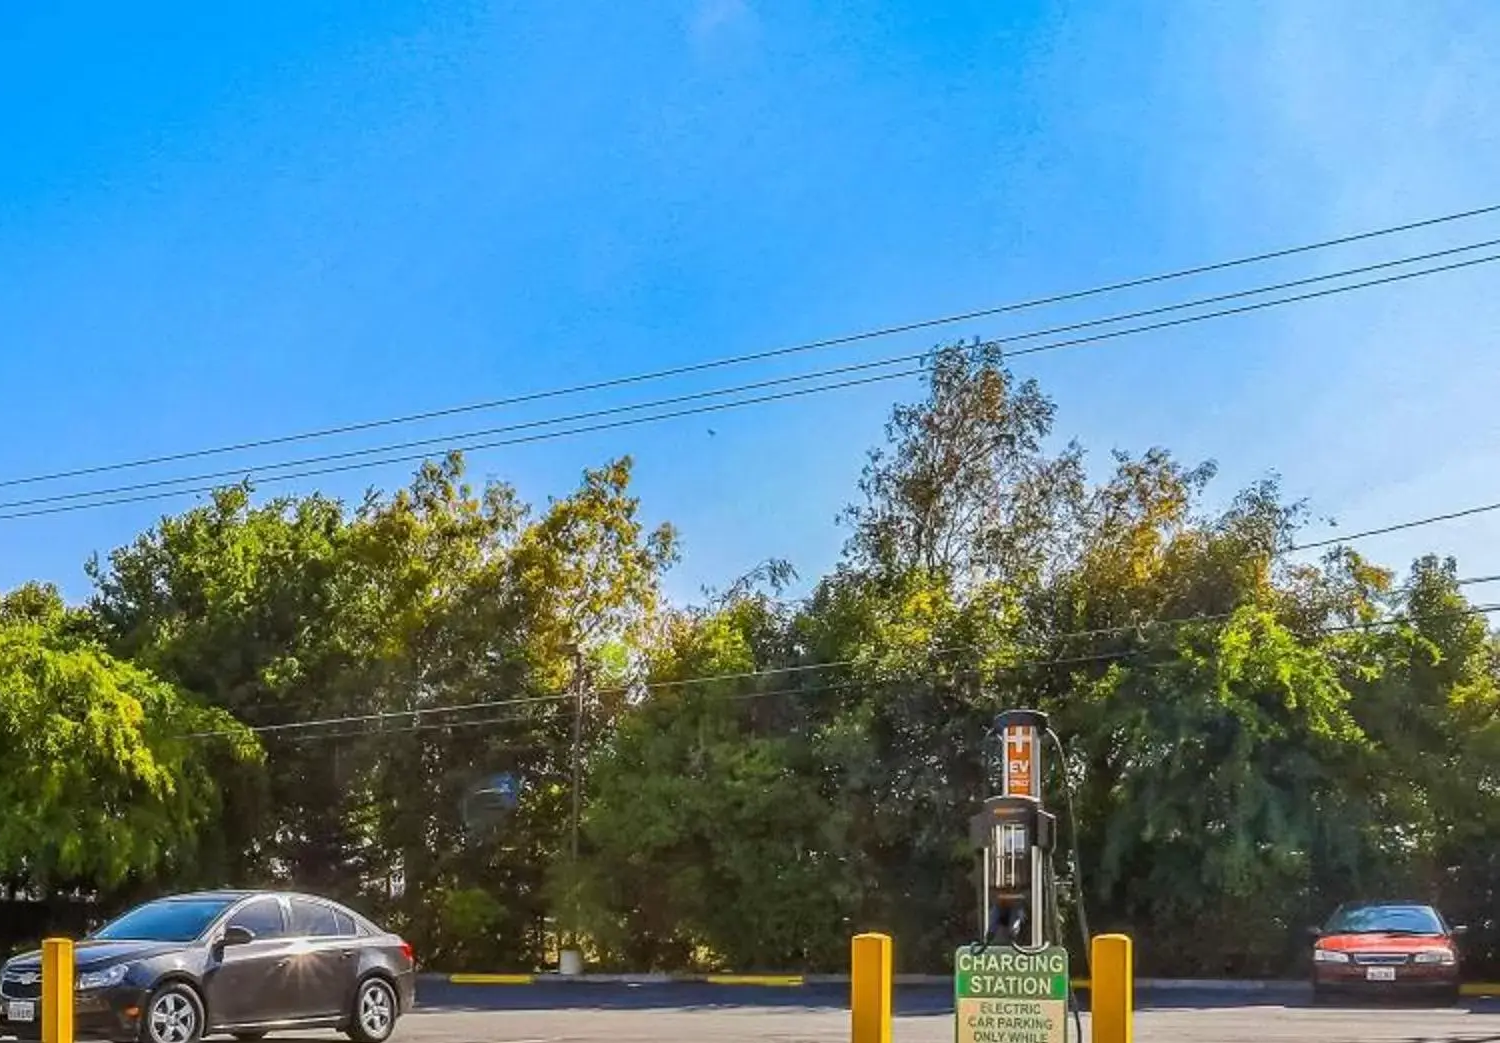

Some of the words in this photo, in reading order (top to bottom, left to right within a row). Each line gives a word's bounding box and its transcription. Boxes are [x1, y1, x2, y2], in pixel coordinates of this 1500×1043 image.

[1009, 760, 1029, 773] EV
[959, 953, 1063, 972] CHARGING
[970, 975, 1052, 994] STATION
[980, 1002, 1041, 1014] ELECTRIC
[968, 1016, 994, 1028] CAR
[997, 1018, 1053, 1030] PARKING
[973, 1031, 1006, 1043] ONLY
